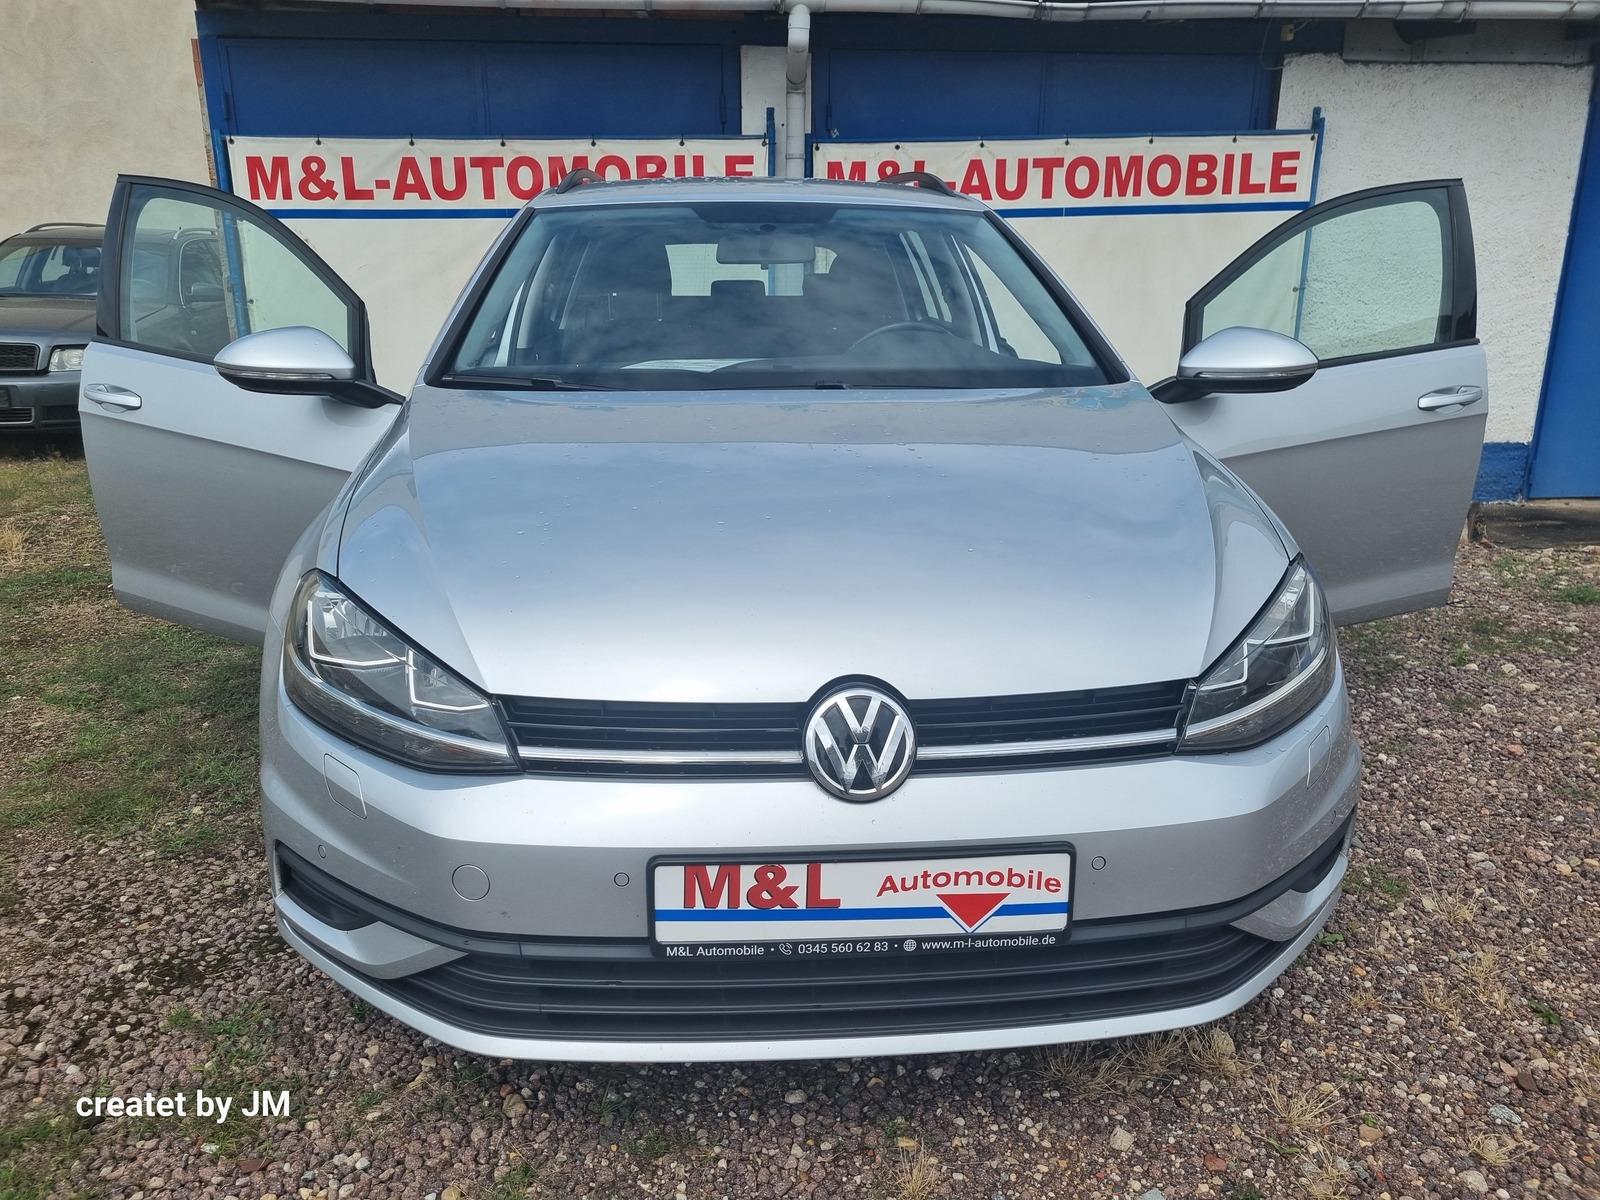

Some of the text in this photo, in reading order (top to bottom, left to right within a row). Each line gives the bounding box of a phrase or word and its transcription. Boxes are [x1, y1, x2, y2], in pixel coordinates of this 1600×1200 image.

[683, 862, 1063, 909] M&L Automobile
[666, 934, 1056, 957] M&L Automobile 0345 560 62 83 www.m-l-automobile.de
